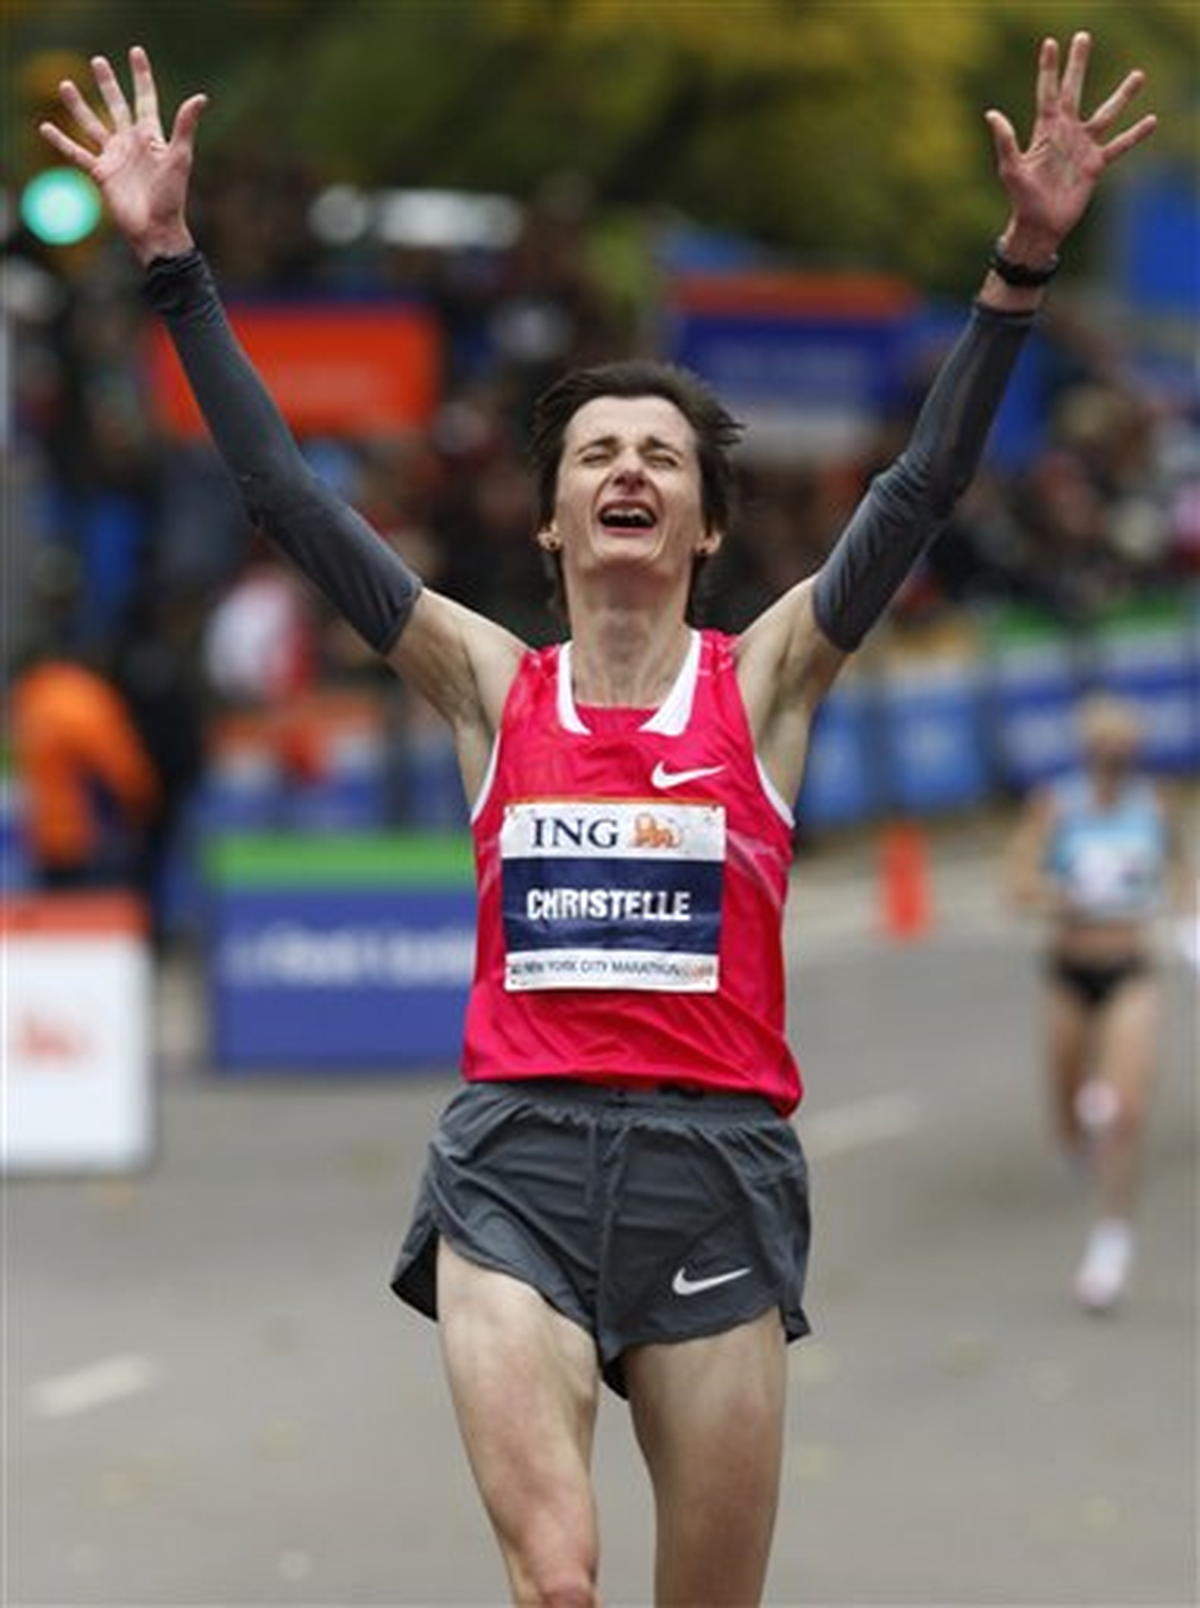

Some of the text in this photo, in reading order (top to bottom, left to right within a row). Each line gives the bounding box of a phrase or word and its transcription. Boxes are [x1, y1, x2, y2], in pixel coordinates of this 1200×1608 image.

[532, 818, 619, 849] ING
[526, 888, 691, 921] CHRISTELLE
[548, 960, 577, 972] YORK
[580, 960, 607, 973] CITY
[611, 960, 680, 976] MARATHON
